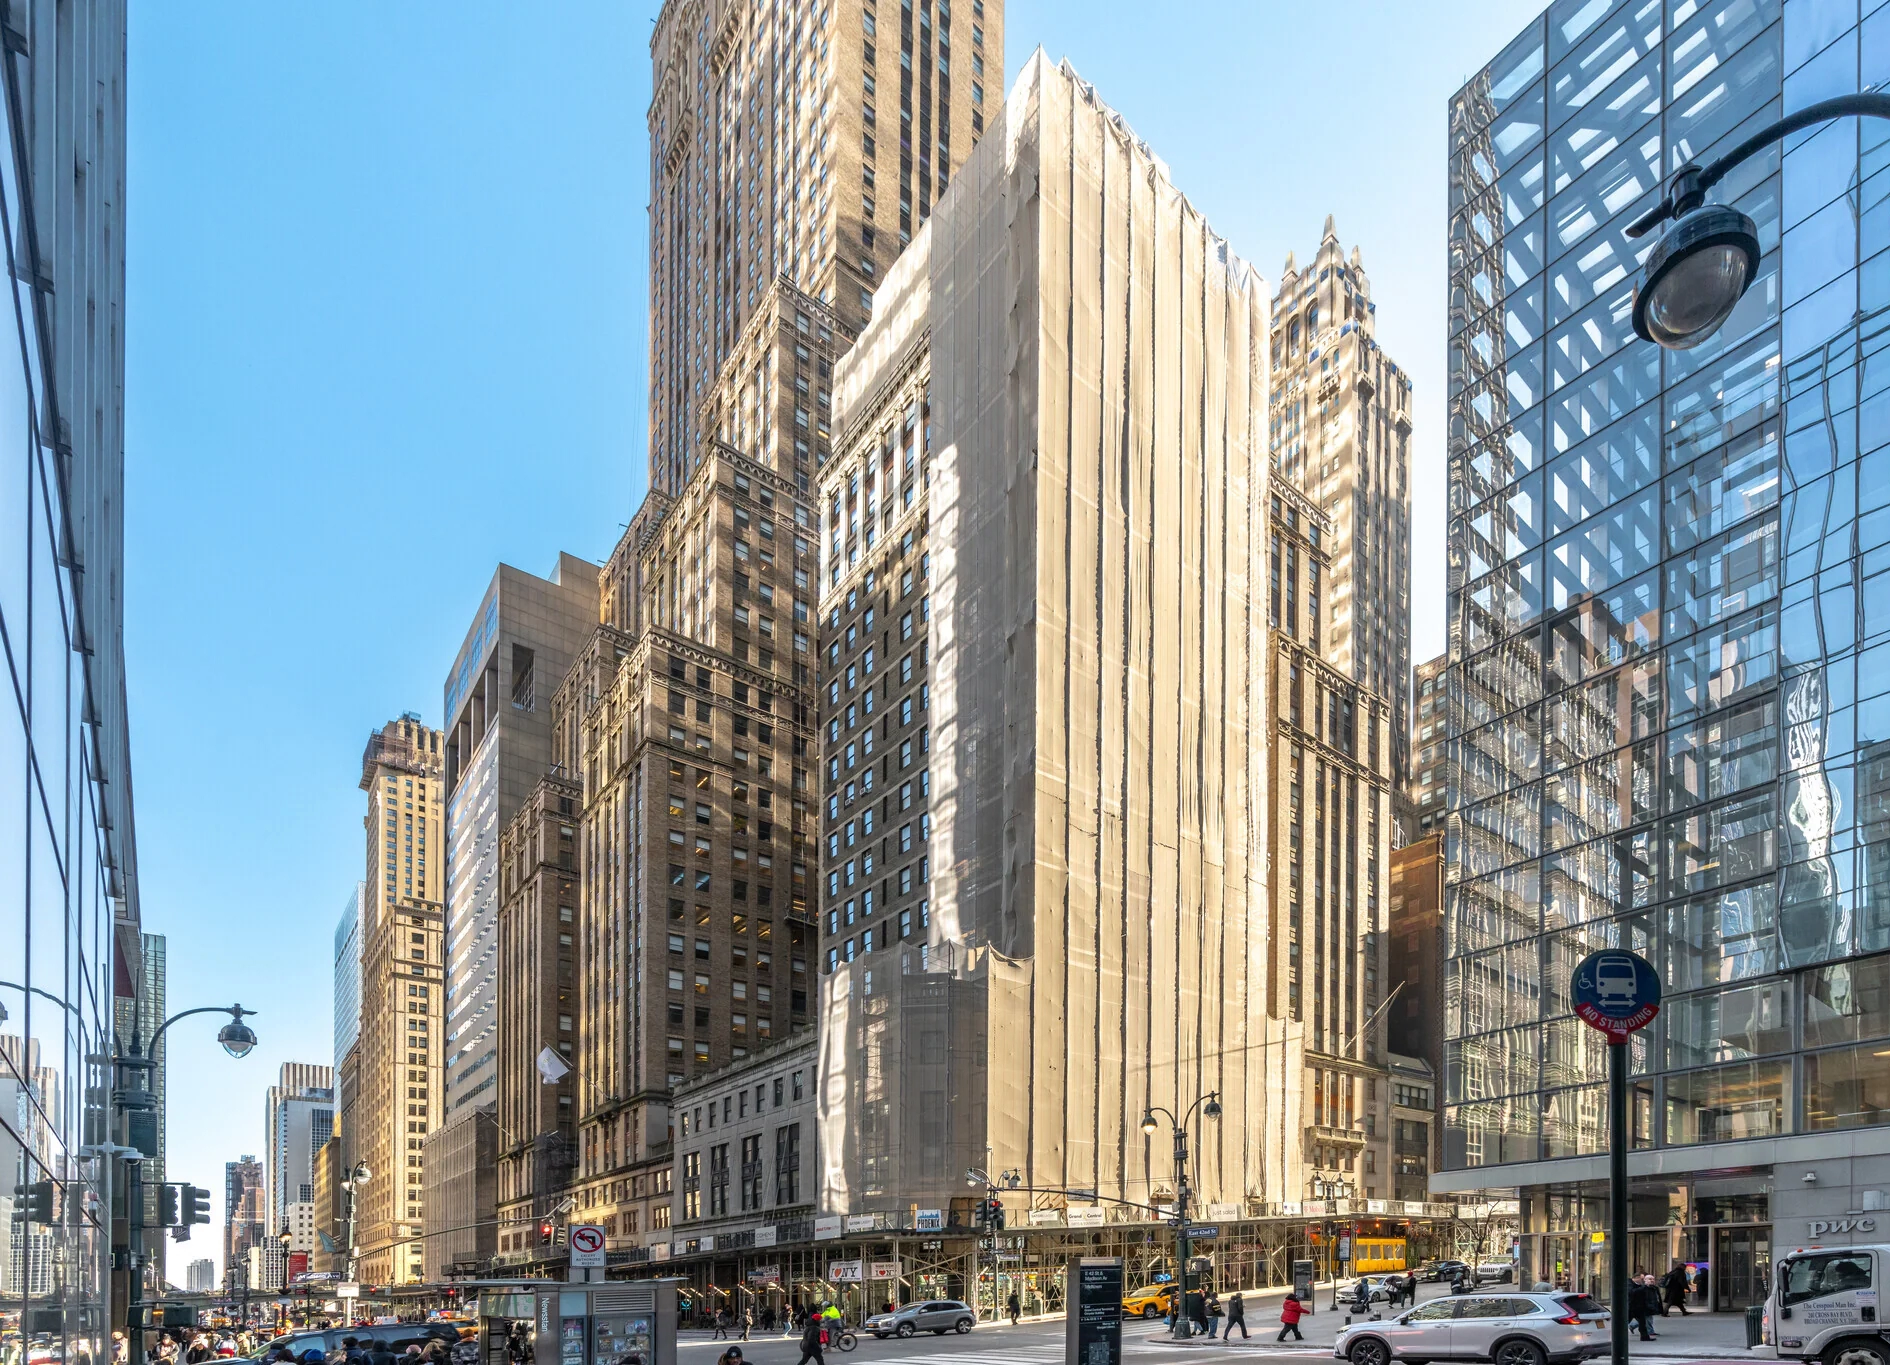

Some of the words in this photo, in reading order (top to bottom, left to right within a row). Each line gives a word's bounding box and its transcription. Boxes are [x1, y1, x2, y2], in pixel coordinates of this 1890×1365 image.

[1583, 1006, 1598, 1021] NO
[1599, 1007, 1652, 1028] STANDING
[917, 1218, 940, 1229] PHOENIX
[1808, 1218, 1874, 1239] pwc
[841, 1267, 858, 1277] NY
[1813, 1301, 1835, 1310] Cesspool
[1835, 1301, 1847, 1309] Man
